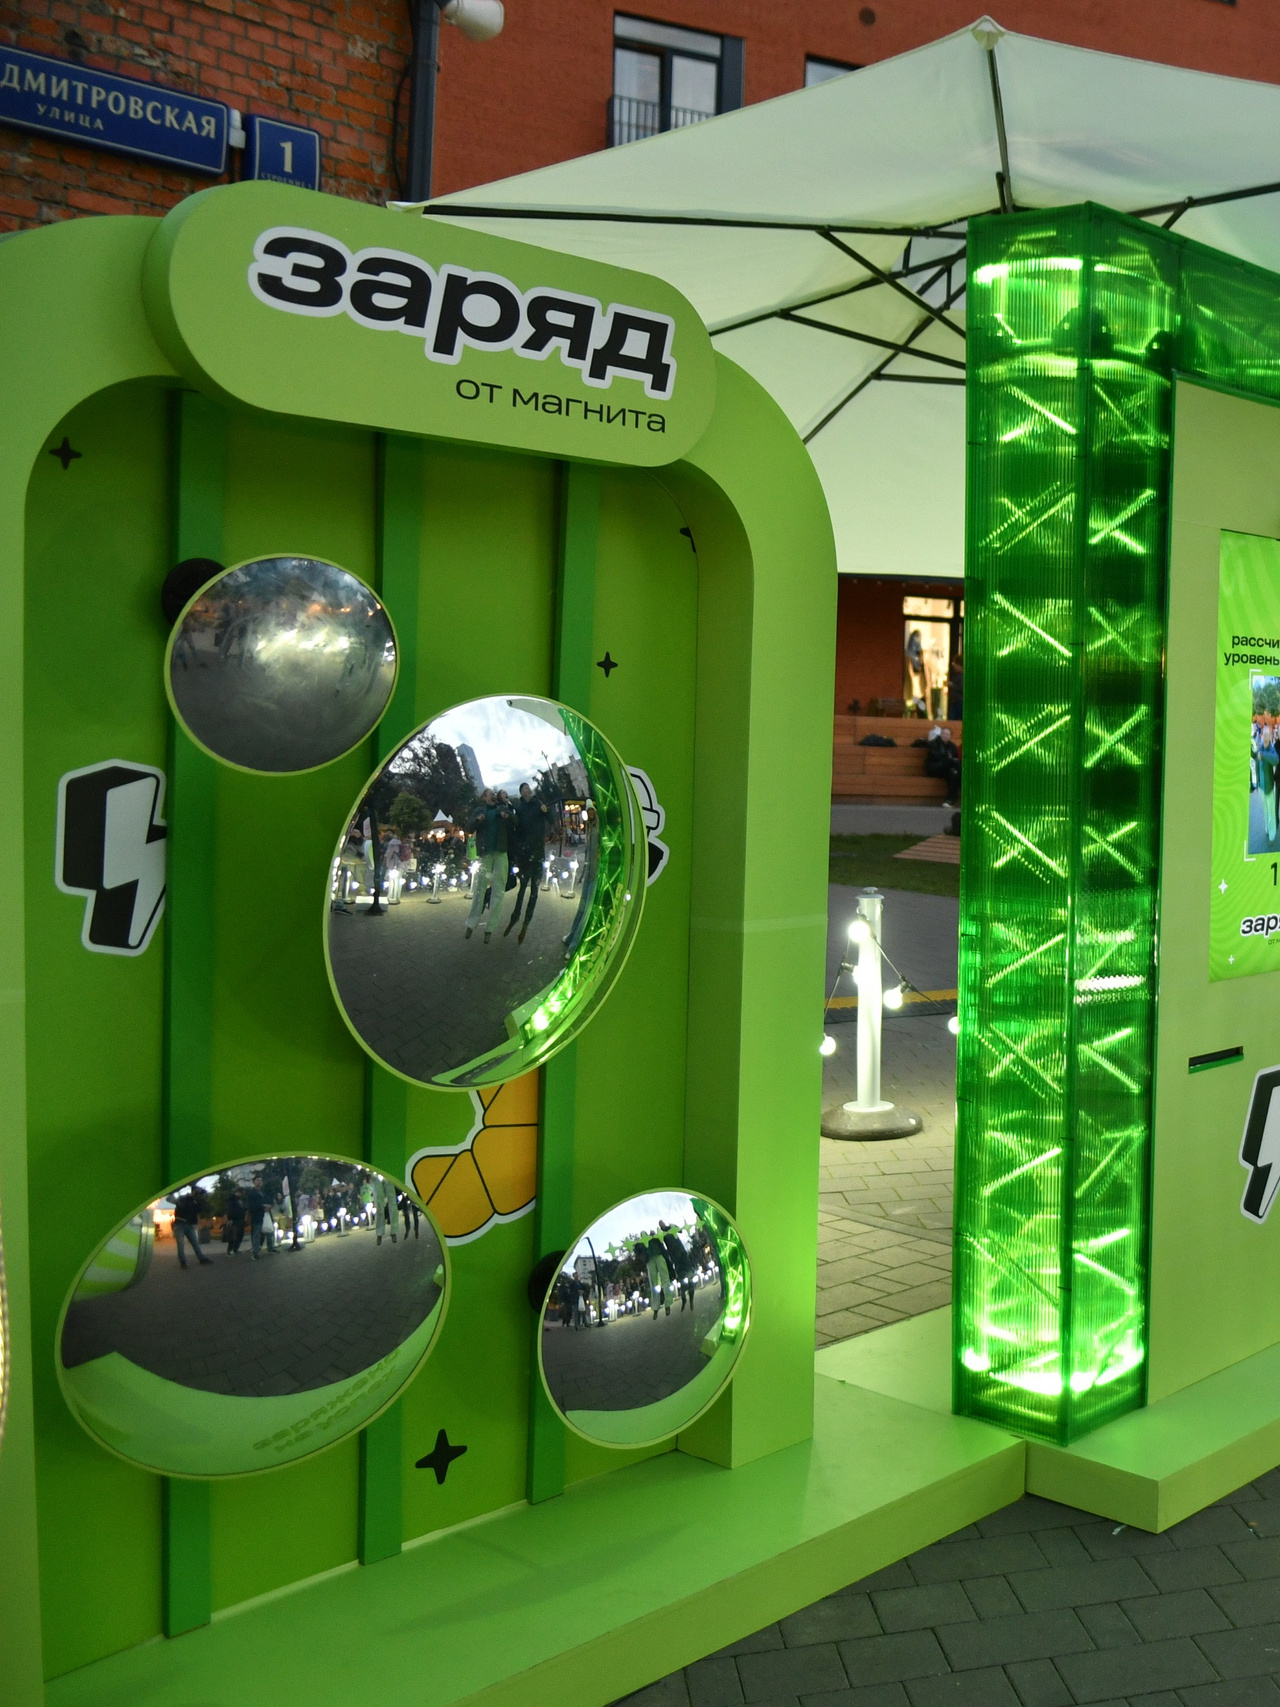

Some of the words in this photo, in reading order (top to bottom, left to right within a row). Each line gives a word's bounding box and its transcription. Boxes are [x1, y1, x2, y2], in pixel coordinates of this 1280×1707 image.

[0, 62, 217, 140] ДМИТРОВСКАЯ
[37, 103, 105, 132] УЛИЦА
[280, 140, 294, 175] 1
[255, 234, 673, 395] заряд
[455, 378, 504, 405] от
[511, 387, 668, 434] магнита
[1223, 652, 1280, 667] уровень
[1270, 861, 1278, 886] 1
